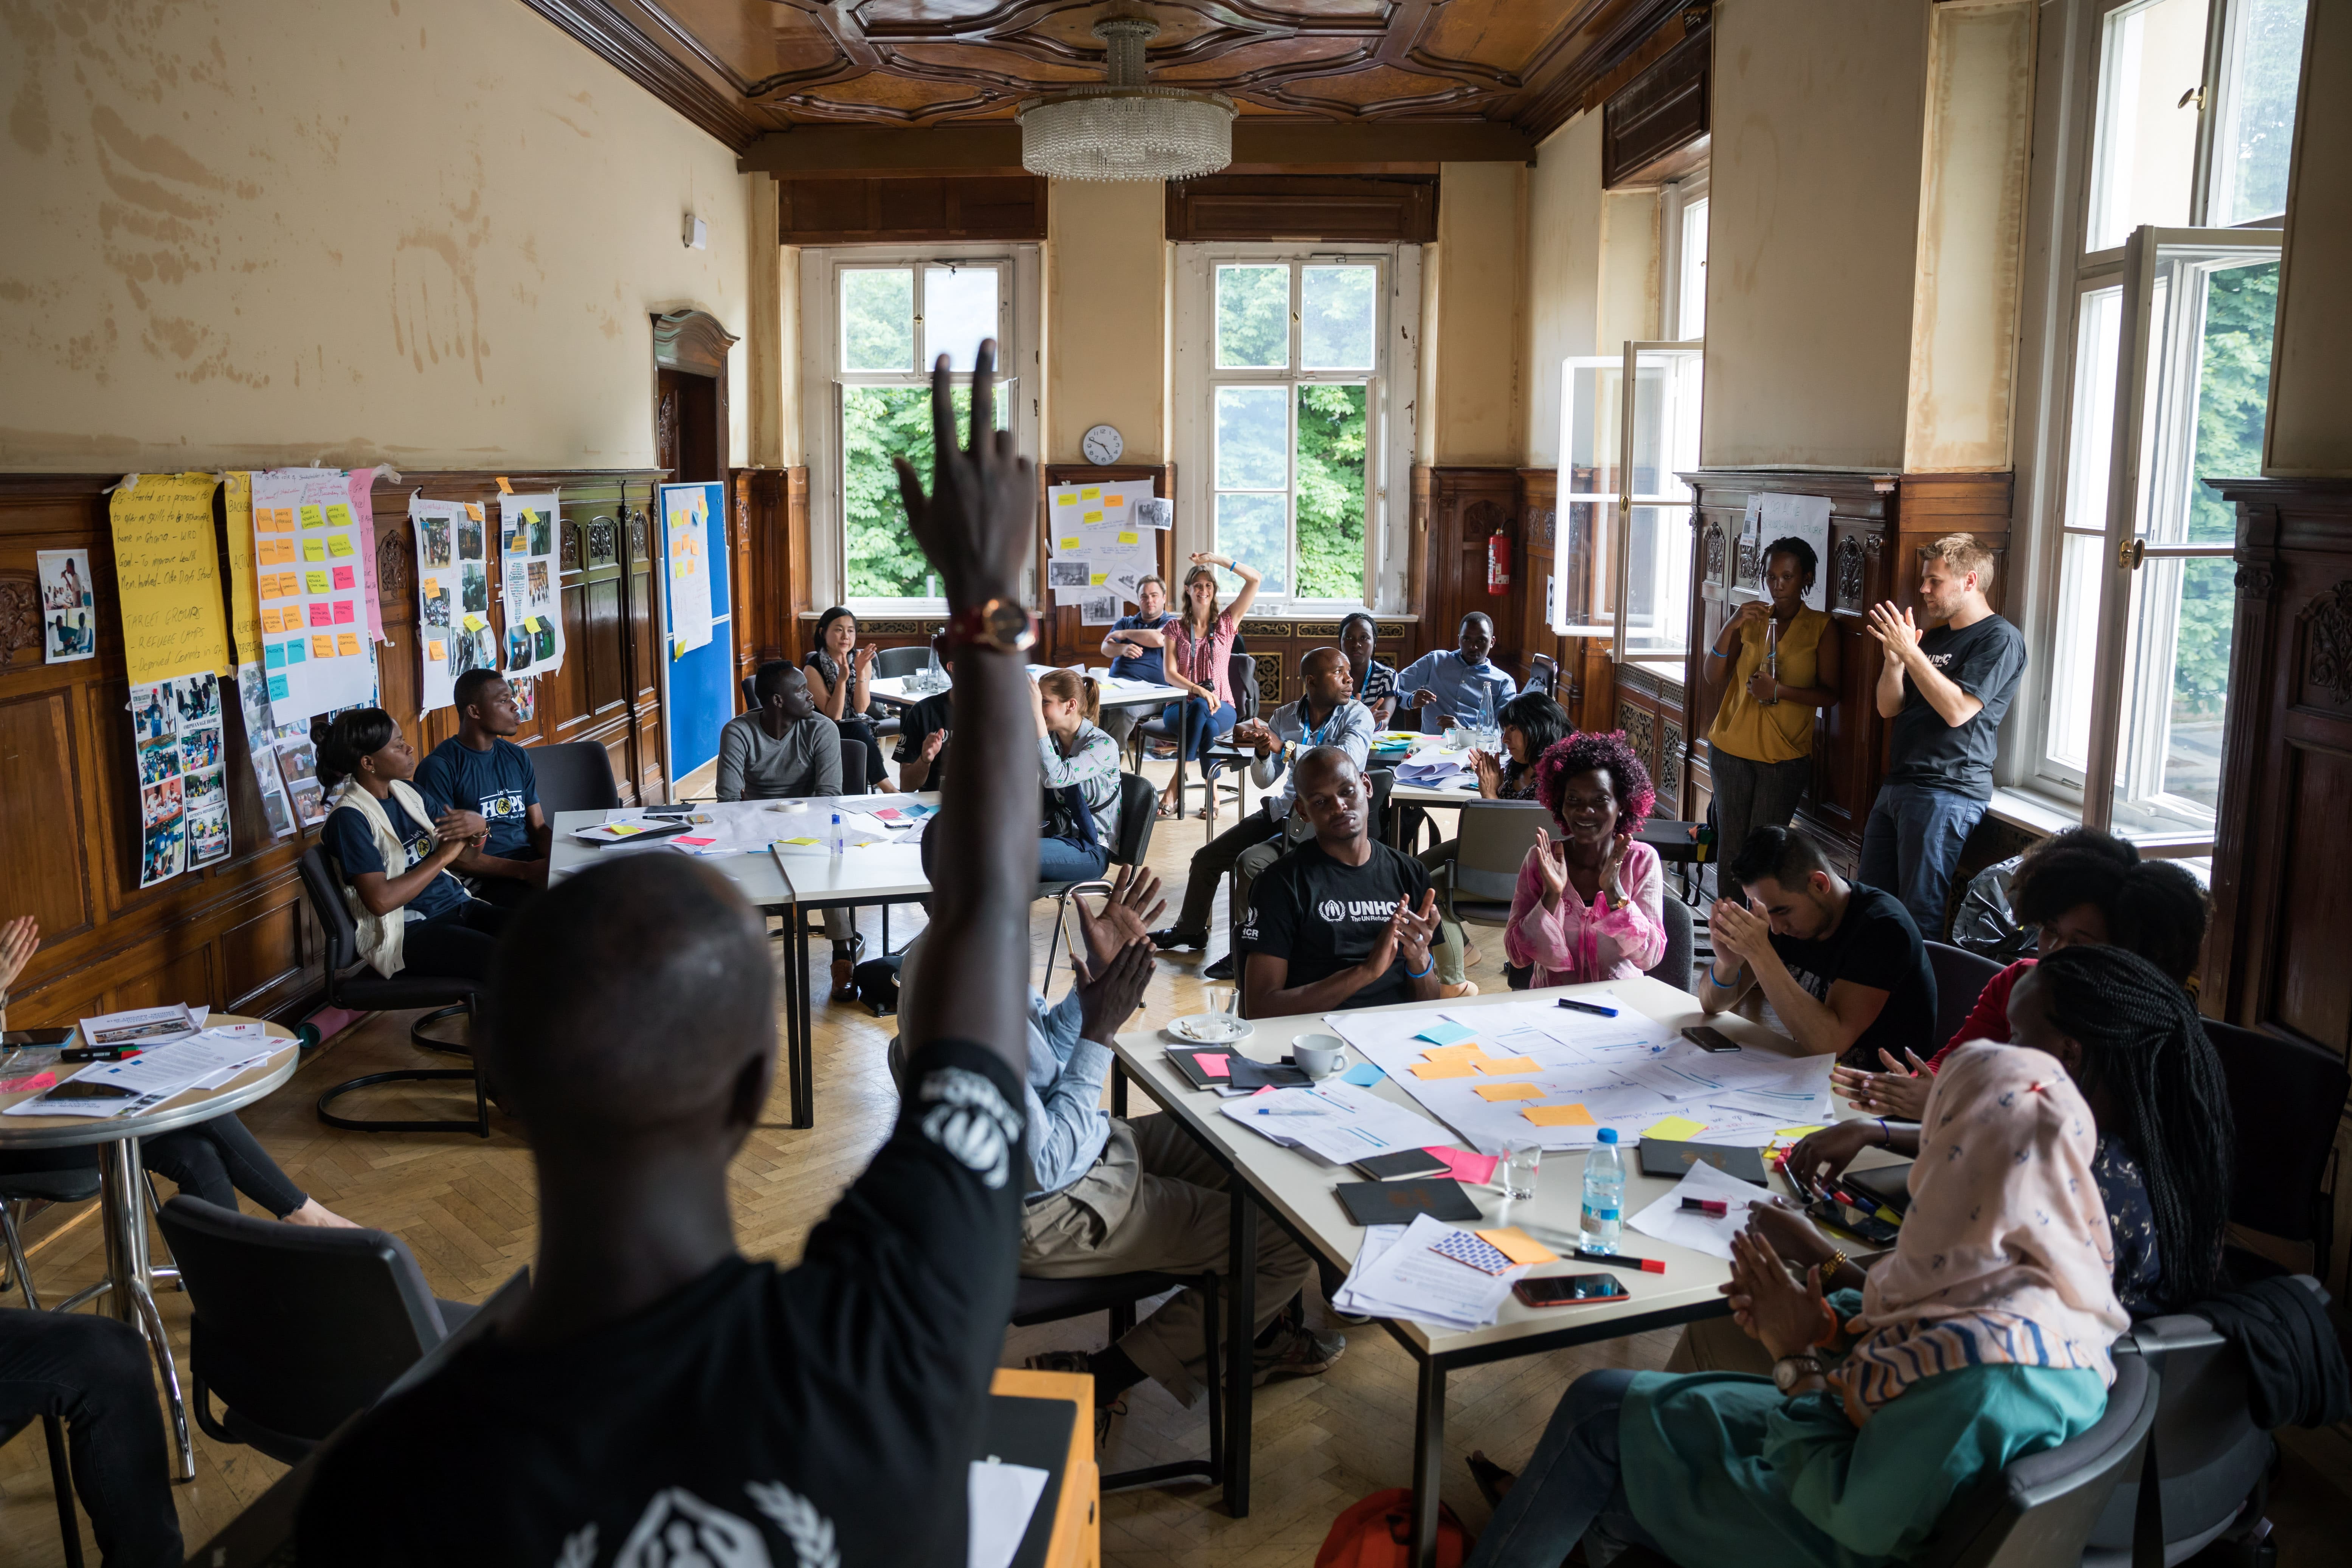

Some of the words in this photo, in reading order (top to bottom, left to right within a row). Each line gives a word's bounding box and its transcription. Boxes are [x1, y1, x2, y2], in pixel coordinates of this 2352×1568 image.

[172, 491, 197, 509] proposal
[200, 489, 209, 499] to
[113, 512, 121, 522] to
[166, 511, 174, 522] to
[117, 530, 132, 543] home
[152, 553, 176, 571] improve
[125, 611, 160, 631] TARGET
[165, 606, 203, 626] GROUPS
[181, 627, 205, 644] CAMPS
[139, 651, 171, 676] Deprived
[203, 646, 211, 656] in
[183, 720, 206, 730] ORPHANAGE
